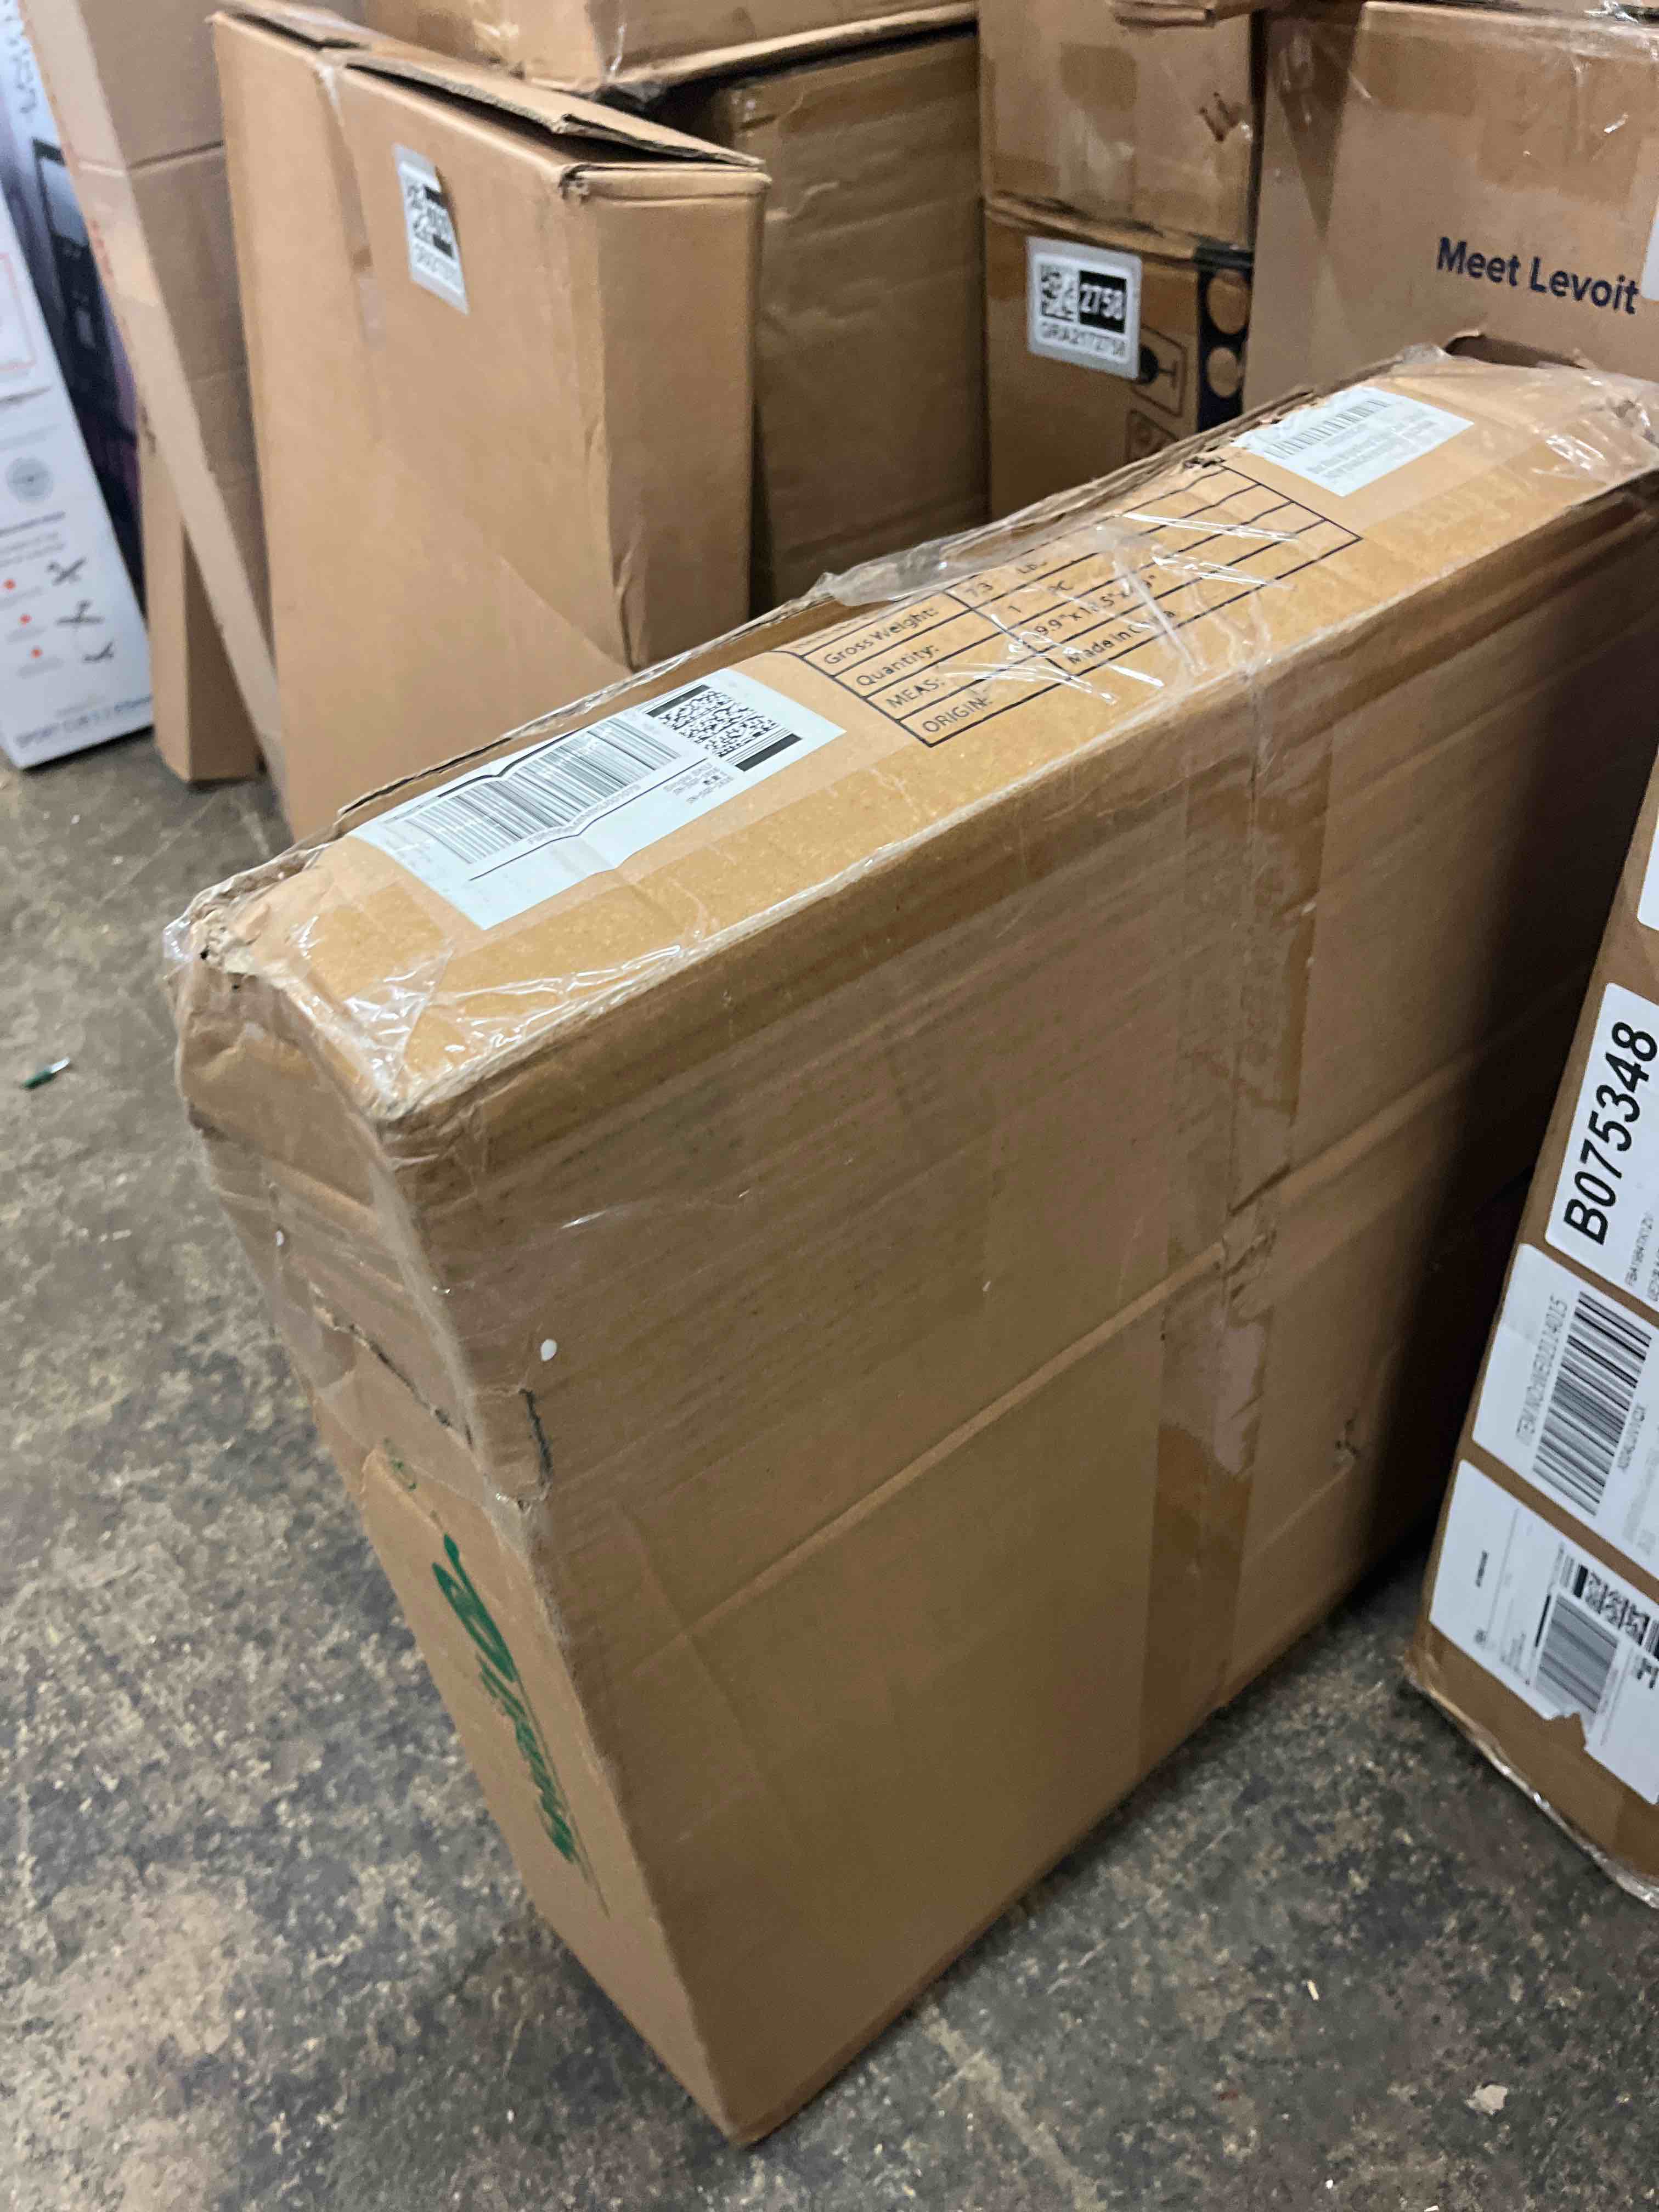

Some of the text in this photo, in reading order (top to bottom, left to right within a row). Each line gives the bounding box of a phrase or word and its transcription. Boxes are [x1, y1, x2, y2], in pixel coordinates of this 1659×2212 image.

[1436, 236, 1639, 315] Meet Levoit
[824, 639, 874, 664] Gross
[869, 607, 939, 641] Weight:
[1066, 639, 1115, 665] Made
[856, 645, 940, 686] Quantity:
[886, 678, 945, 708] MEAS:
[1563, 1021, 1658, 1246] B075348
